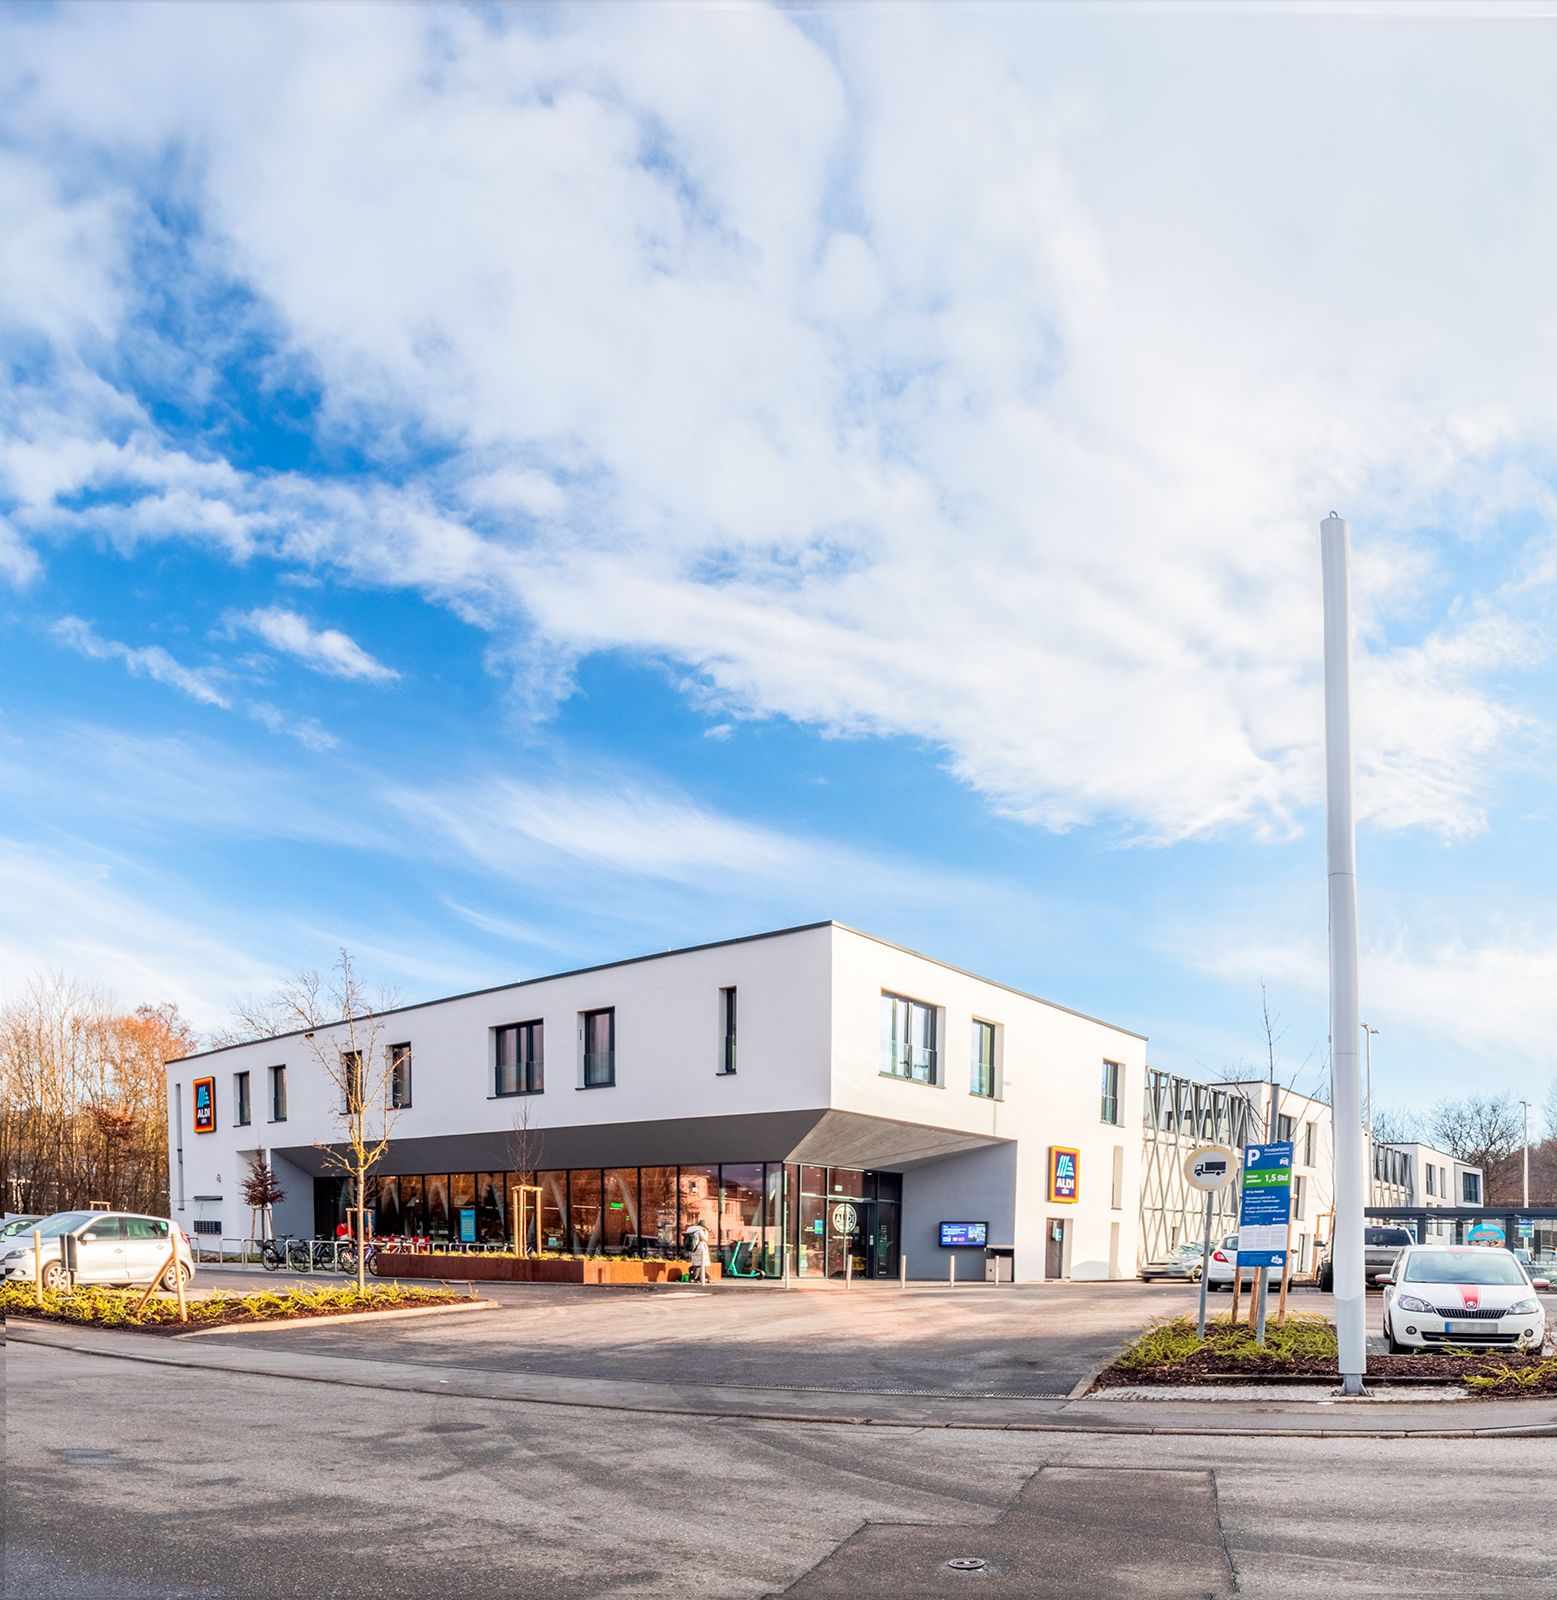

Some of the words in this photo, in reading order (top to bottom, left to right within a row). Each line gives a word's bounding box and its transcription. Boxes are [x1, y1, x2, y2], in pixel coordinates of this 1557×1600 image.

[197, 1108, 210, 1118] ALDI
[1247, 1149, 1260, 1167] P
[1056, 1178, 1074, 1189] ALDI
[1265, 1174, 1276, 1183] 1,5
[1277, 1174, 1288, 1182] Std
[835, 1214, 855, 1223] ALDI
